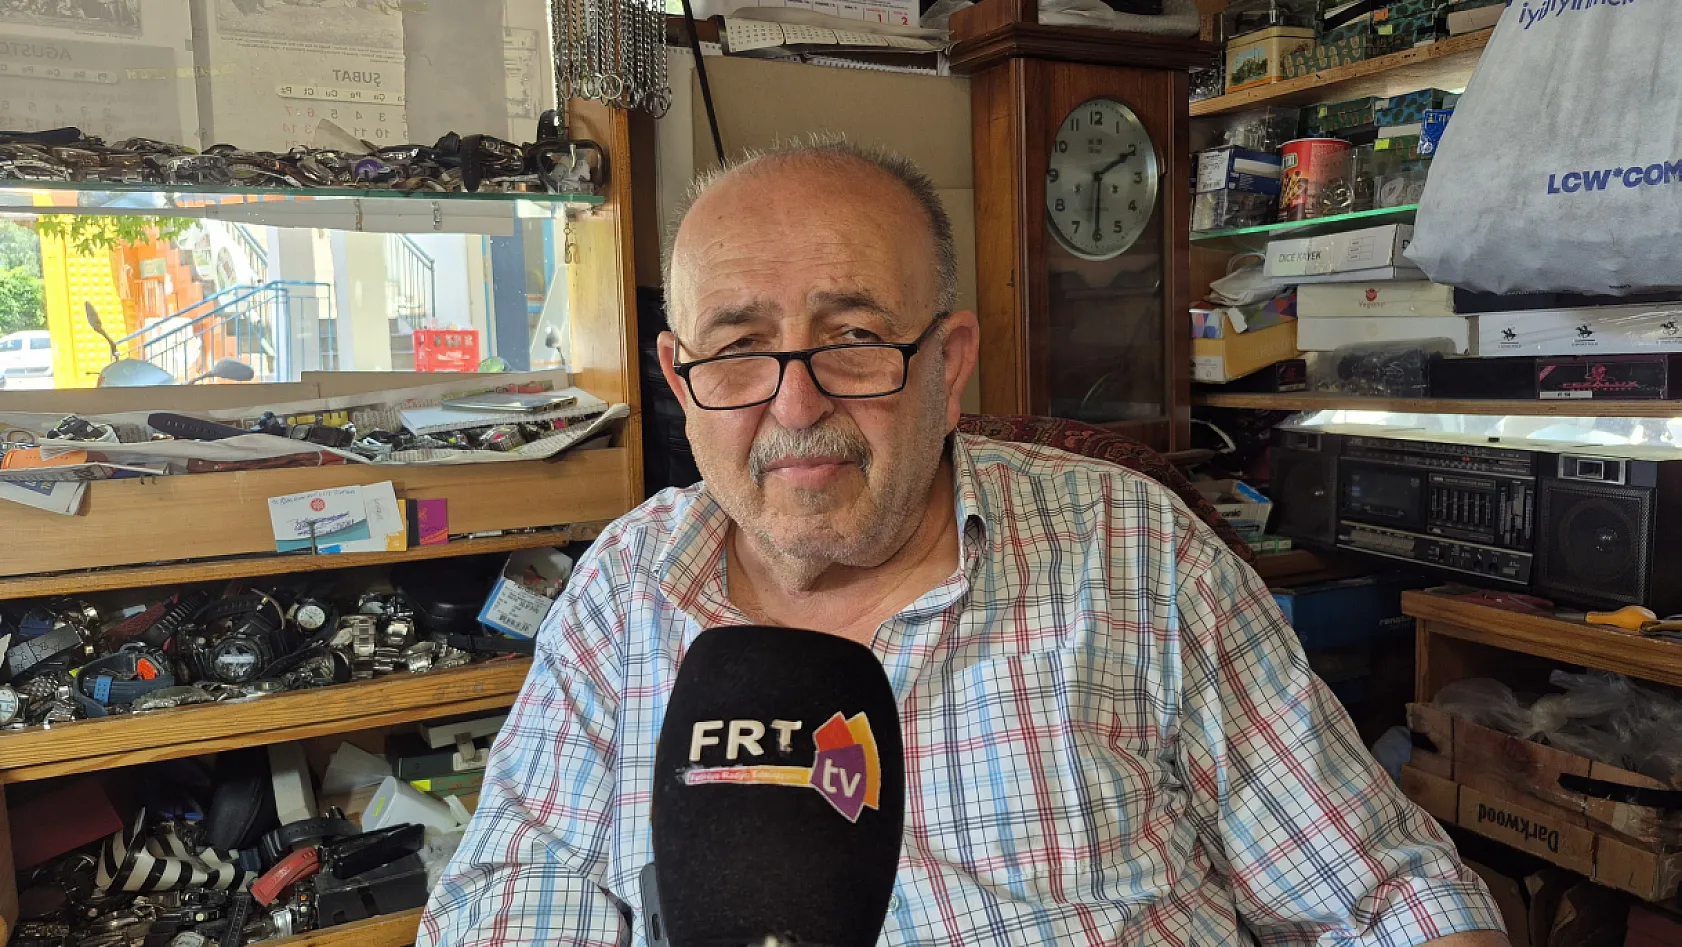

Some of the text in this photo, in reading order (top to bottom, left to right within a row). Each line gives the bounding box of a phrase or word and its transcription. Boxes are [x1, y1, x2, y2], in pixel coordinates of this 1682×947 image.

[877, 13, 908, 26] 1 2
[1070, 119, 1080, 132] 11
[1089, 112, 1103, 126] 12
[1115, 122, 1120, 134] 1
[1053, 141, 1068, 153] 10
[1126, 145, 1137, 157] 2
[1048, 169, 1059, 183] 9
[1133, 172, 1143, 184] 3
[1054, 199, 1066, 212] 8
[1127, 200, 1137, 212] 4
[1071, 221, 1081, 234] 7
[1113, 221, 1122, 233] 5
[1091, 228, 1103, 242] 6
[688, 718, 803, 762] FRT
[822, 757, 861, 798] tv
[1477, 802, 1560, 854] Darkwood
